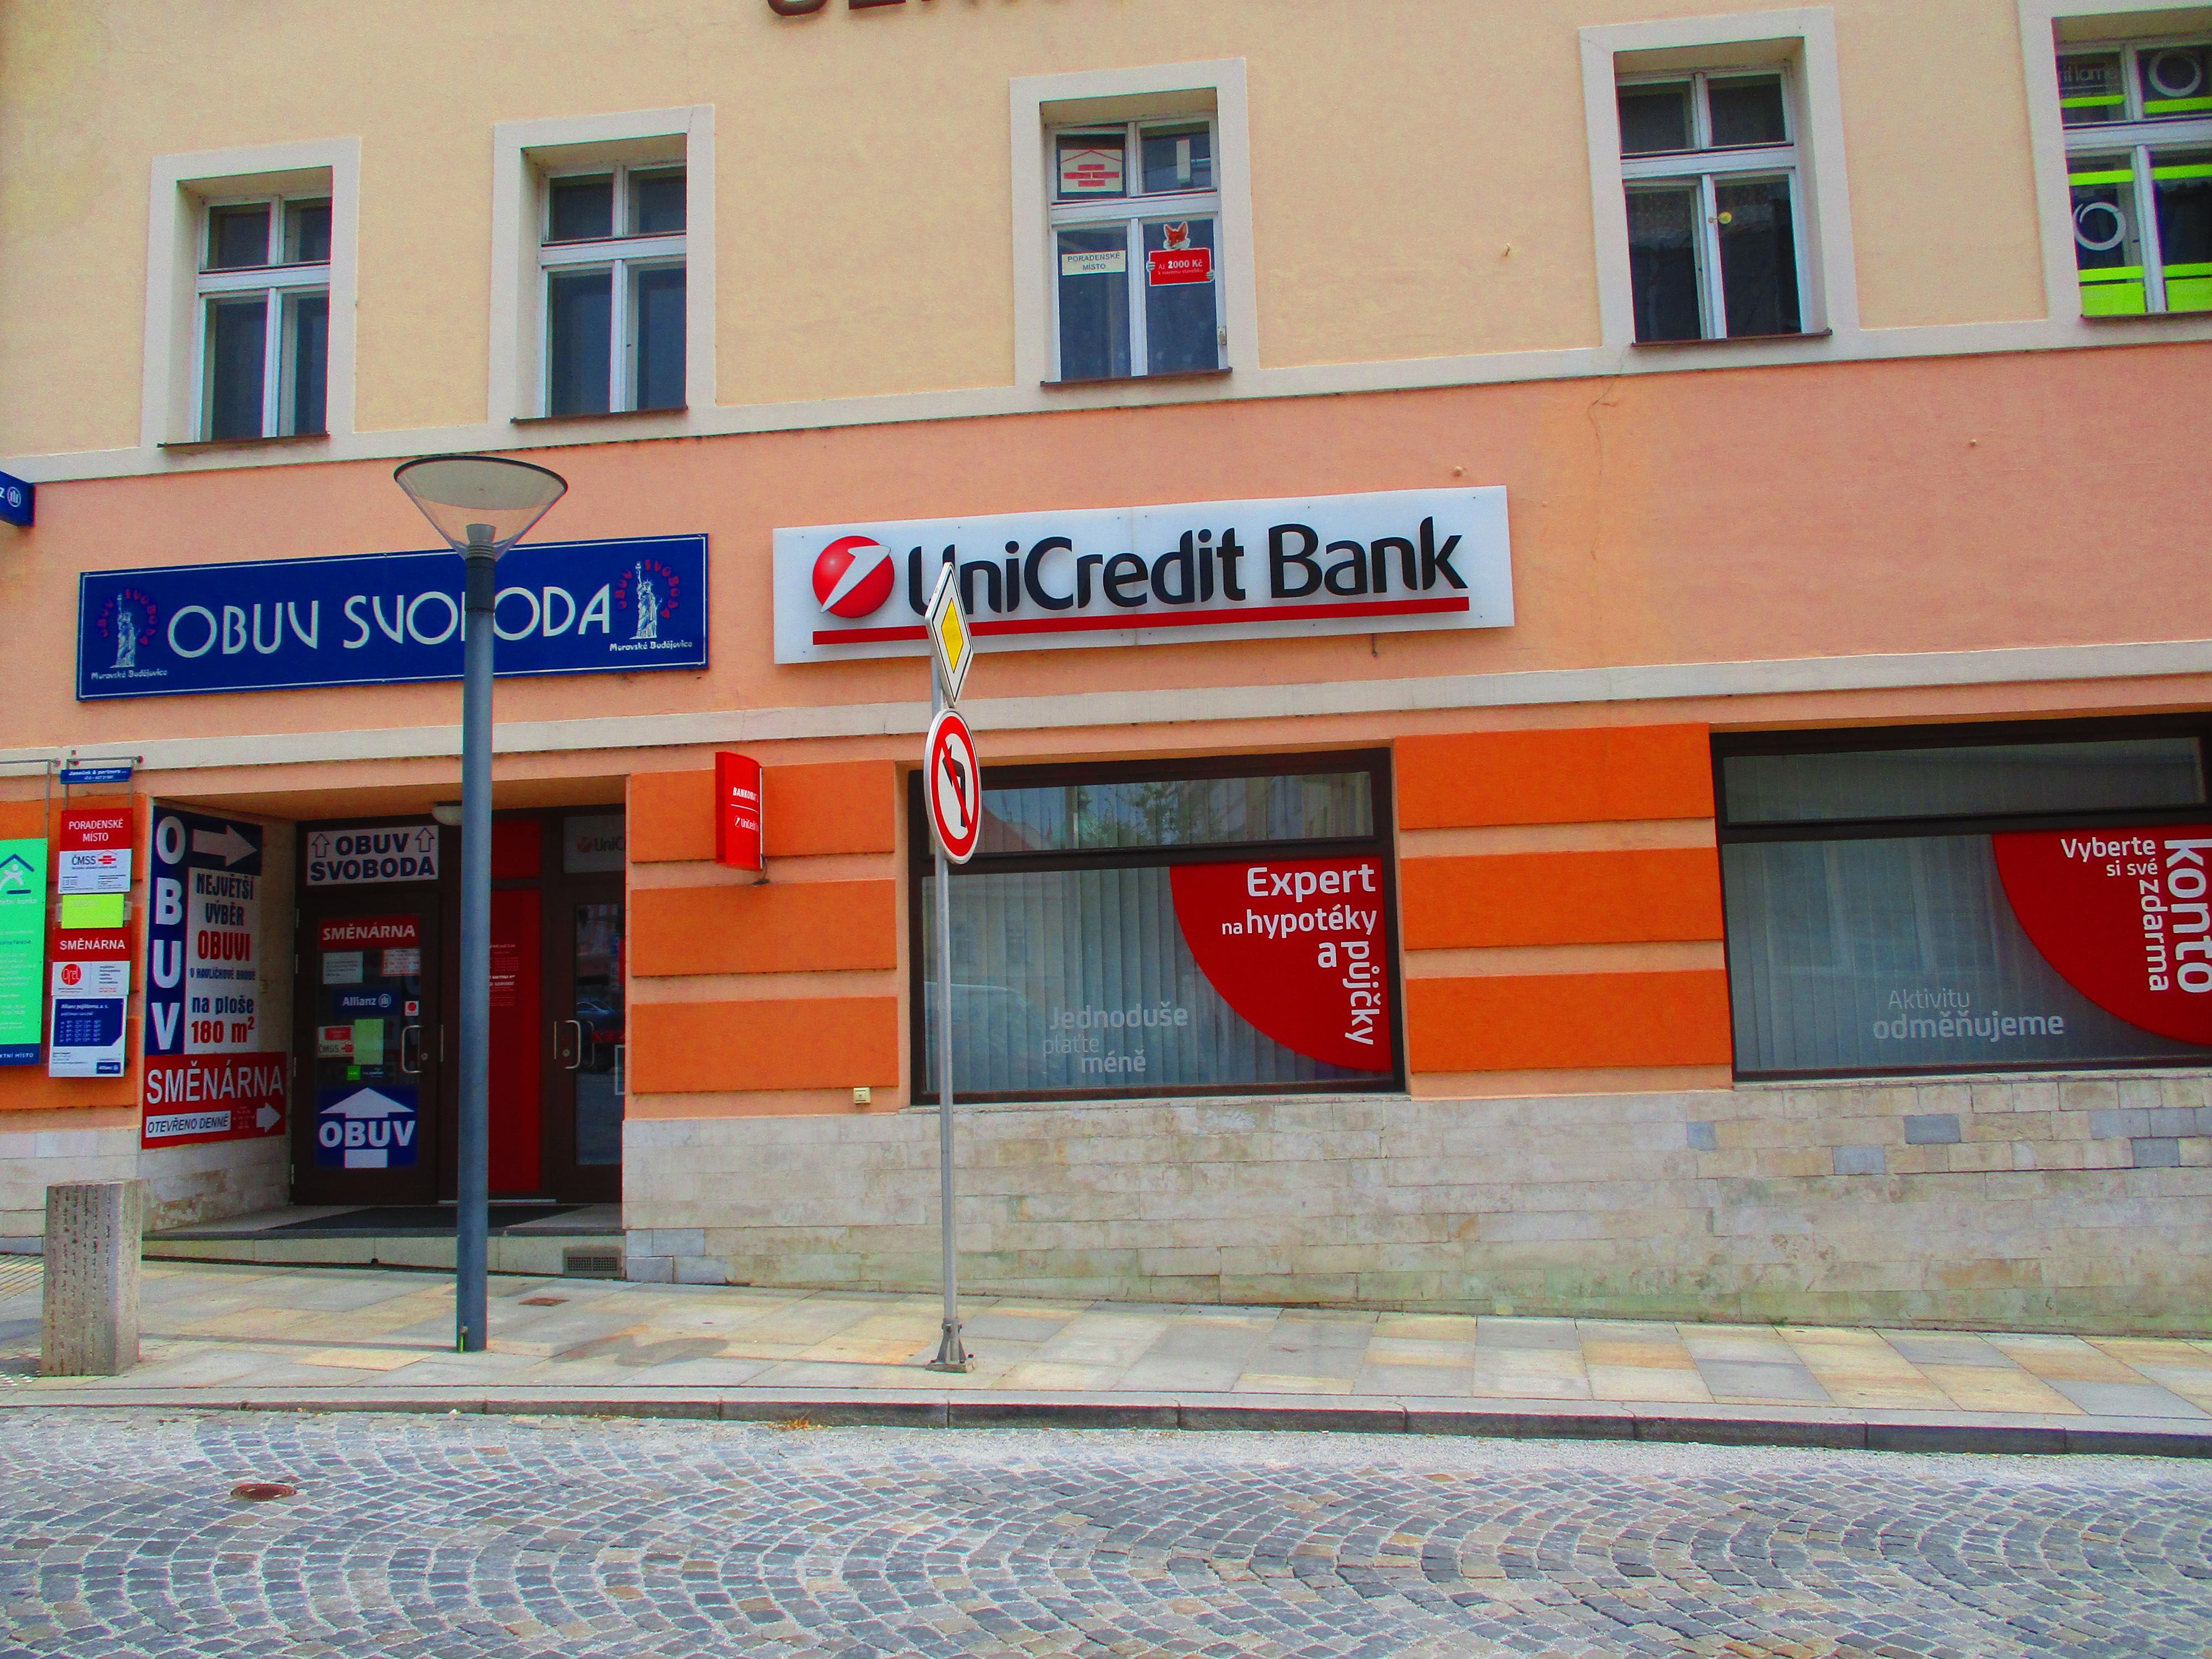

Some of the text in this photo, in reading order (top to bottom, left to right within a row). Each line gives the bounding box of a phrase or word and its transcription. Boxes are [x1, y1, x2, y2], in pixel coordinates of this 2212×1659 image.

[1067, 252, 1120, 262] PORADENSKÉ
[1082, 263, 1106, 271] MÍSTO
[1167, 259, 1190, 269] 2000
[1192, 259, 1203, 267] Kč
[908, 515, 1469, 618] UniCredit Bank
[167, 583, 610, 659] OBUV SVOODA
[609, 640, 693, 651] Moravské Budějovice
[68, 817, 124, 830] PORADENSKÉ
[82, 831, 109, 842] MÍSTO
[336, 832, 410, 856] OBUV
[71, 853, 96, 865] ČMSS
[2060, 837, 2157, 863] Vyberte
[310, 856, 436, 881] SVOBODA
[2106, 857, 2158, 877] si své
[196, 873, 255, 900] NEJVĚTŠÍ
[1247, 863, 1376, 903] Expert
[205, 900, 245, 926] VÝBĚR
[1222, 903, 1378, 940] na hypotéky
[2163, 838, 2212, 994] konto
[151, 816, 186, 1050] OBUV
[322, 921, 416, 941] SMĚNÁRNA
[2139, 879, 2169, 992] zdarma
[59, 937, 126, 951] SMĚNÁRNA
[197, 930, 252, 961] OBUVI
[192, 995, 255, 1015] na ploše
[342, 996, 377, 1007] Allianz
[1317, 941, 1381, 1045] a půjčky
[1888, 987, 1970, 1010] Aktivitu
[1049, 1001, 1189, 1030] Jednoduše
[1872, 1010, 2065, 1044] odměňujeme
[191, 1020, 225, 1044] 180
[1081, 1049, 1147, 1073] méně
[146, 1059, 284, 1105] SMĚNÁRNA
[147, 1117, 197, 1134] OTEVŘENO
[199, 1113, 229, 1129] DENNĚ
[319, 1120, 416, 1149] OBUV
